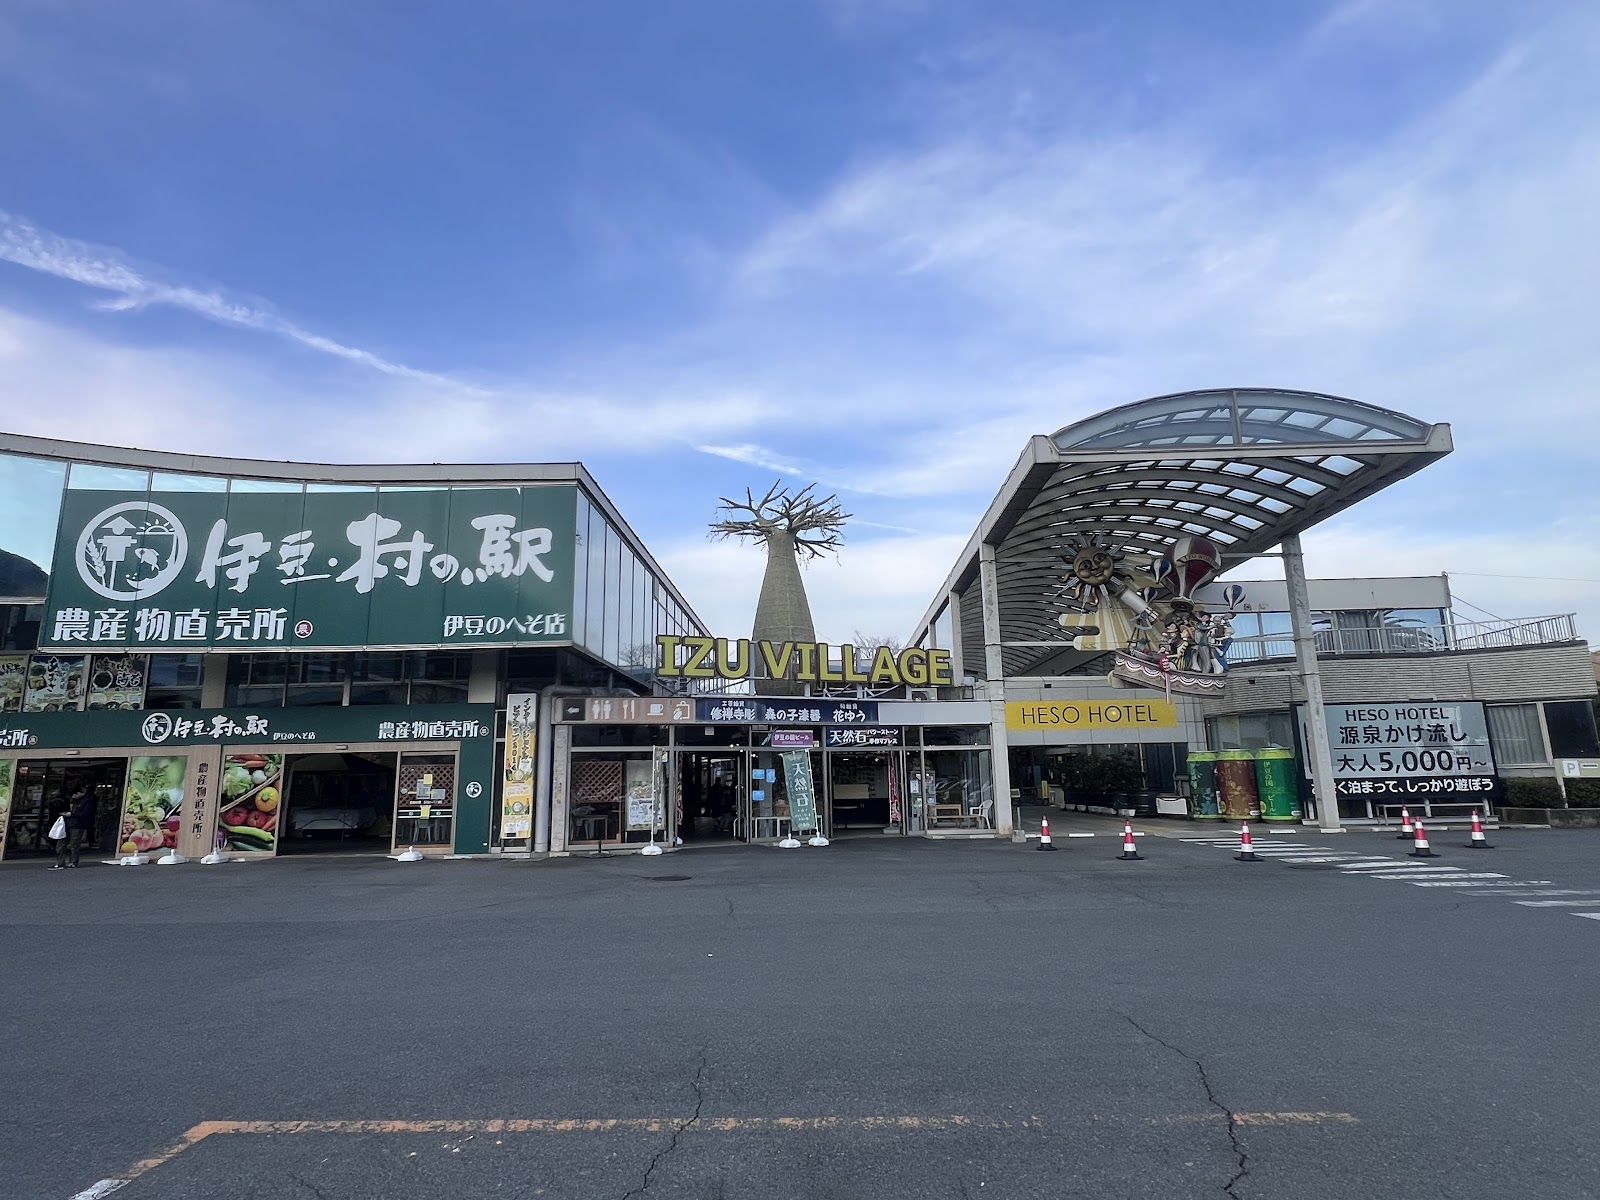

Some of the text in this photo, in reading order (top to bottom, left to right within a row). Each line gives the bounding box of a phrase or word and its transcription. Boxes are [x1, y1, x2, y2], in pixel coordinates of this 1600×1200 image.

[51, 607, 288, 642] 農産物直売所
[443, 613, 566, 637] 伊豆のへそ店
[656, 635, 951, 686] IZU VILLAGE
[765, 707, 822, 721] 森の子漆器
[832, 709, 866, 722] 花ゆう
[1022, 705, 1158, 724] HESO HOTEL
[1345, 707, 1450, 722] HESO HOTEL
[378, 720, 480, 739] 農産物直売所
[829, 729, 867, 744] 天然石
[1339, 723, 1468, 744] 源泉かけ流し
[1567, 763, 1575, 774] P
[1311, 778, 1494, 795] く泊まって、しっかり遊ぼう
